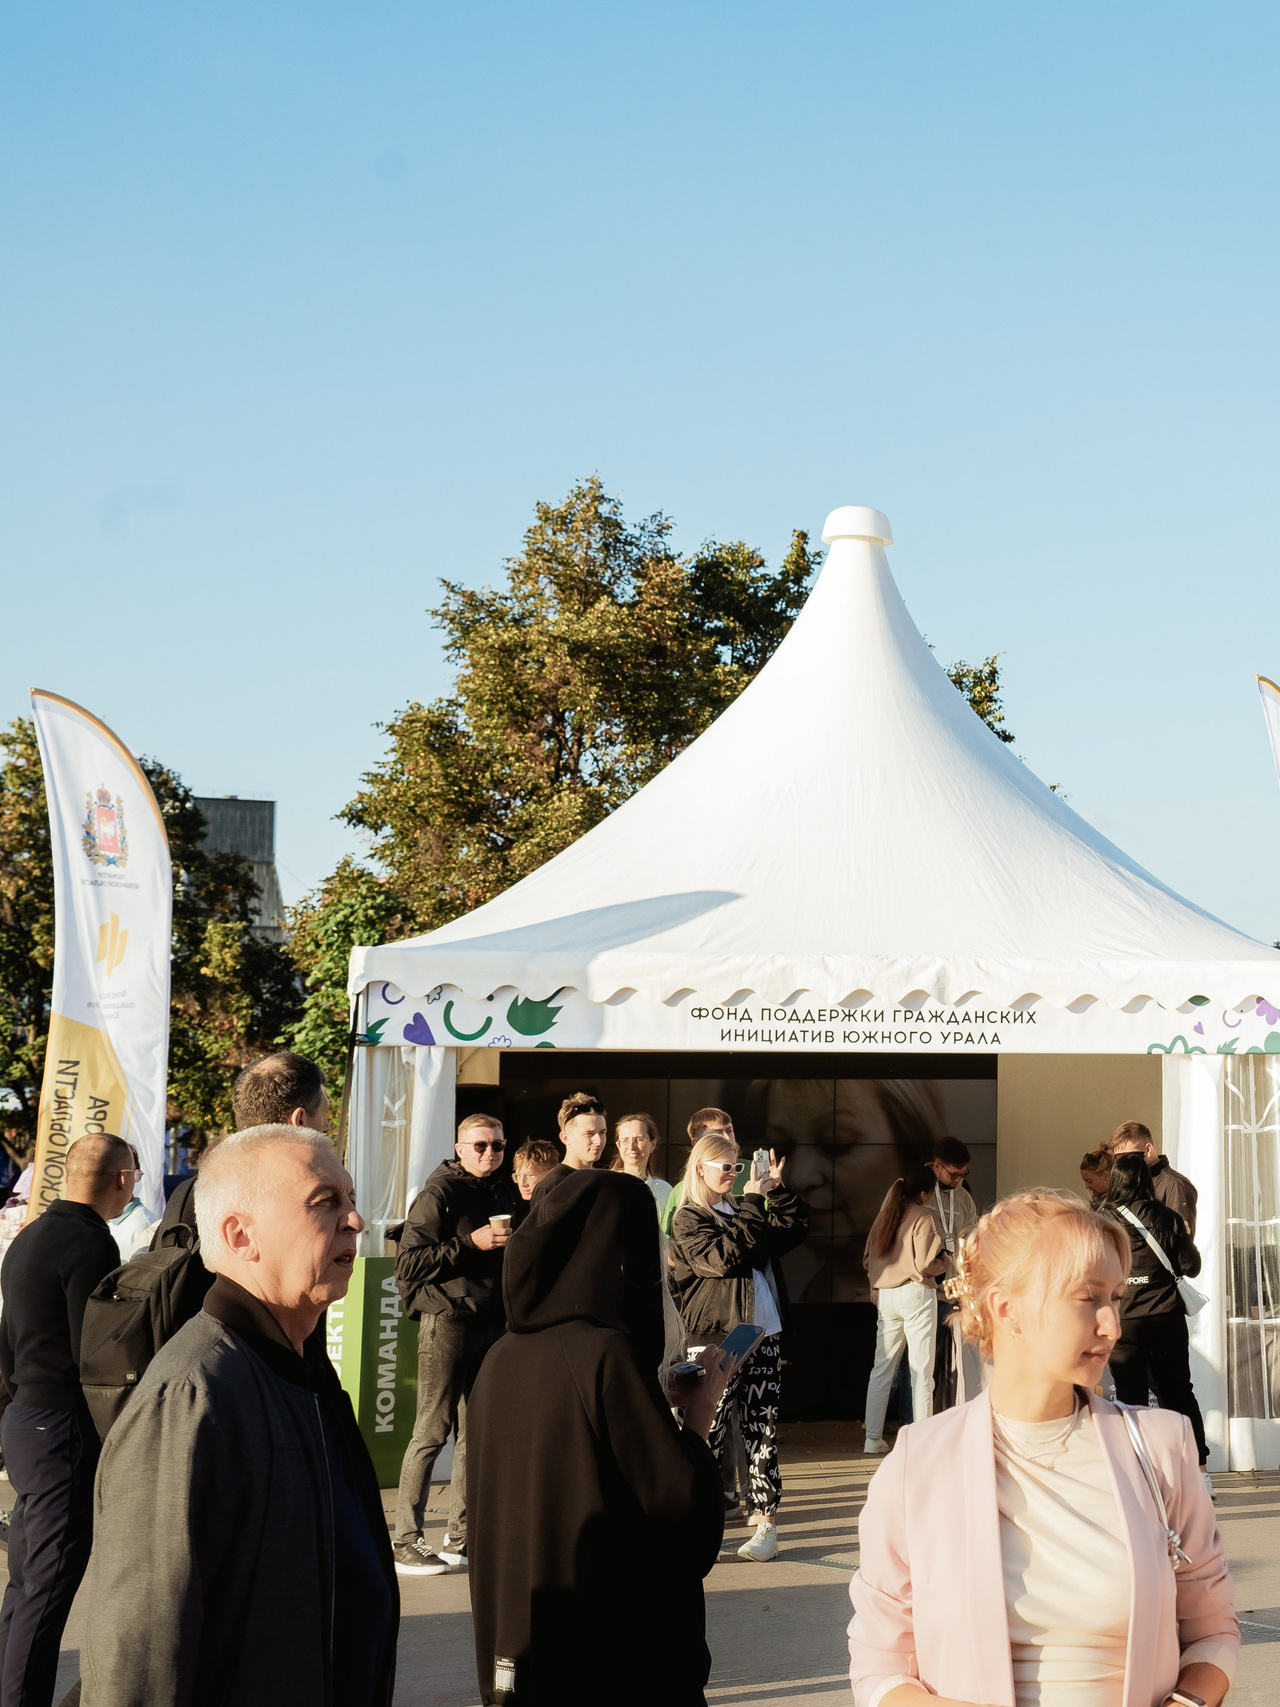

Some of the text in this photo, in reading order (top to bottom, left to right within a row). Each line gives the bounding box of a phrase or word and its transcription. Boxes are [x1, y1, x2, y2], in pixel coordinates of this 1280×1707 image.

[691, 1007, 1037, 1026] ФОНД ПОДДЕРЖКИ ГРАЖДАНСКИХ
[720, 1029, 1002, 1045] ИНИЦИАТИВ ЮЖНОГО УРАЛА
[375, 1275, 403, 1433] КОМАНДА
